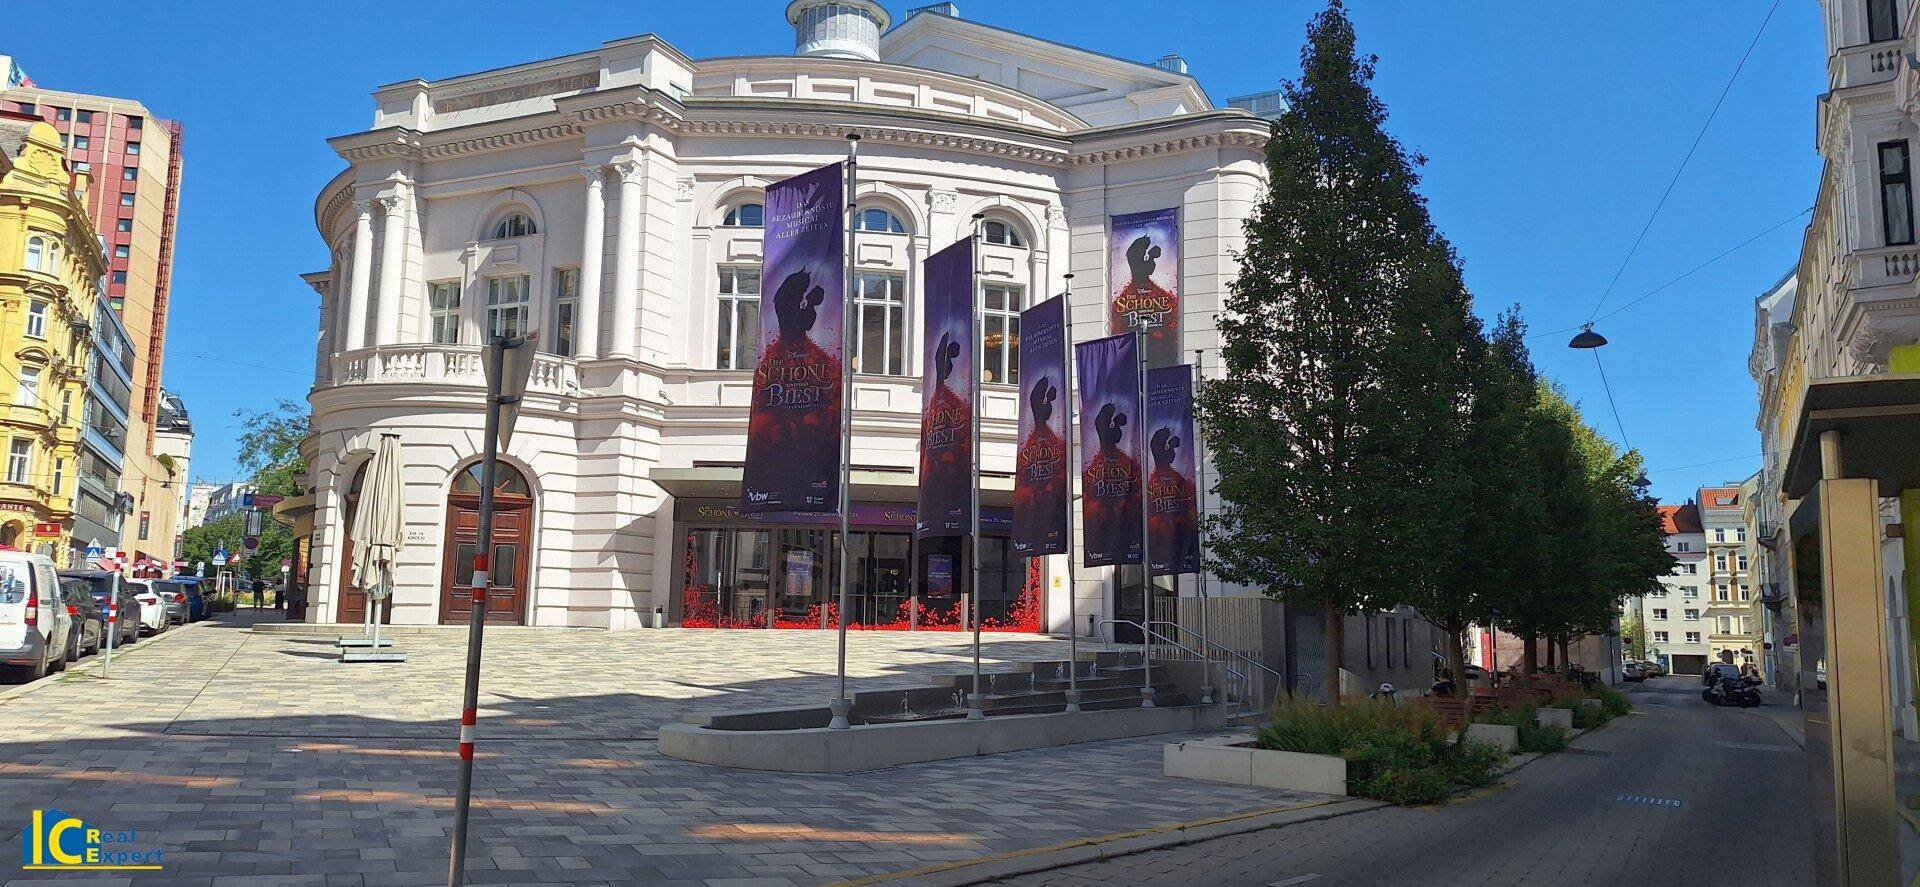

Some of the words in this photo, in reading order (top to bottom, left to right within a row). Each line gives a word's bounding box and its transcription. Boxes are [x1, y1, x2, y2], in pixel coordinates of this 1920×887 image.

[786, 214, 820, 229] MUSICAL
[775, 228, 800, 239] ALLER
[1116, 296, 1172, 313] SCHÖNE
[755, 362, 835, 386] SCHÖNE
[764, 384, 821, 407] BIEST
[1093, 480, 1131, 497] BIEST
